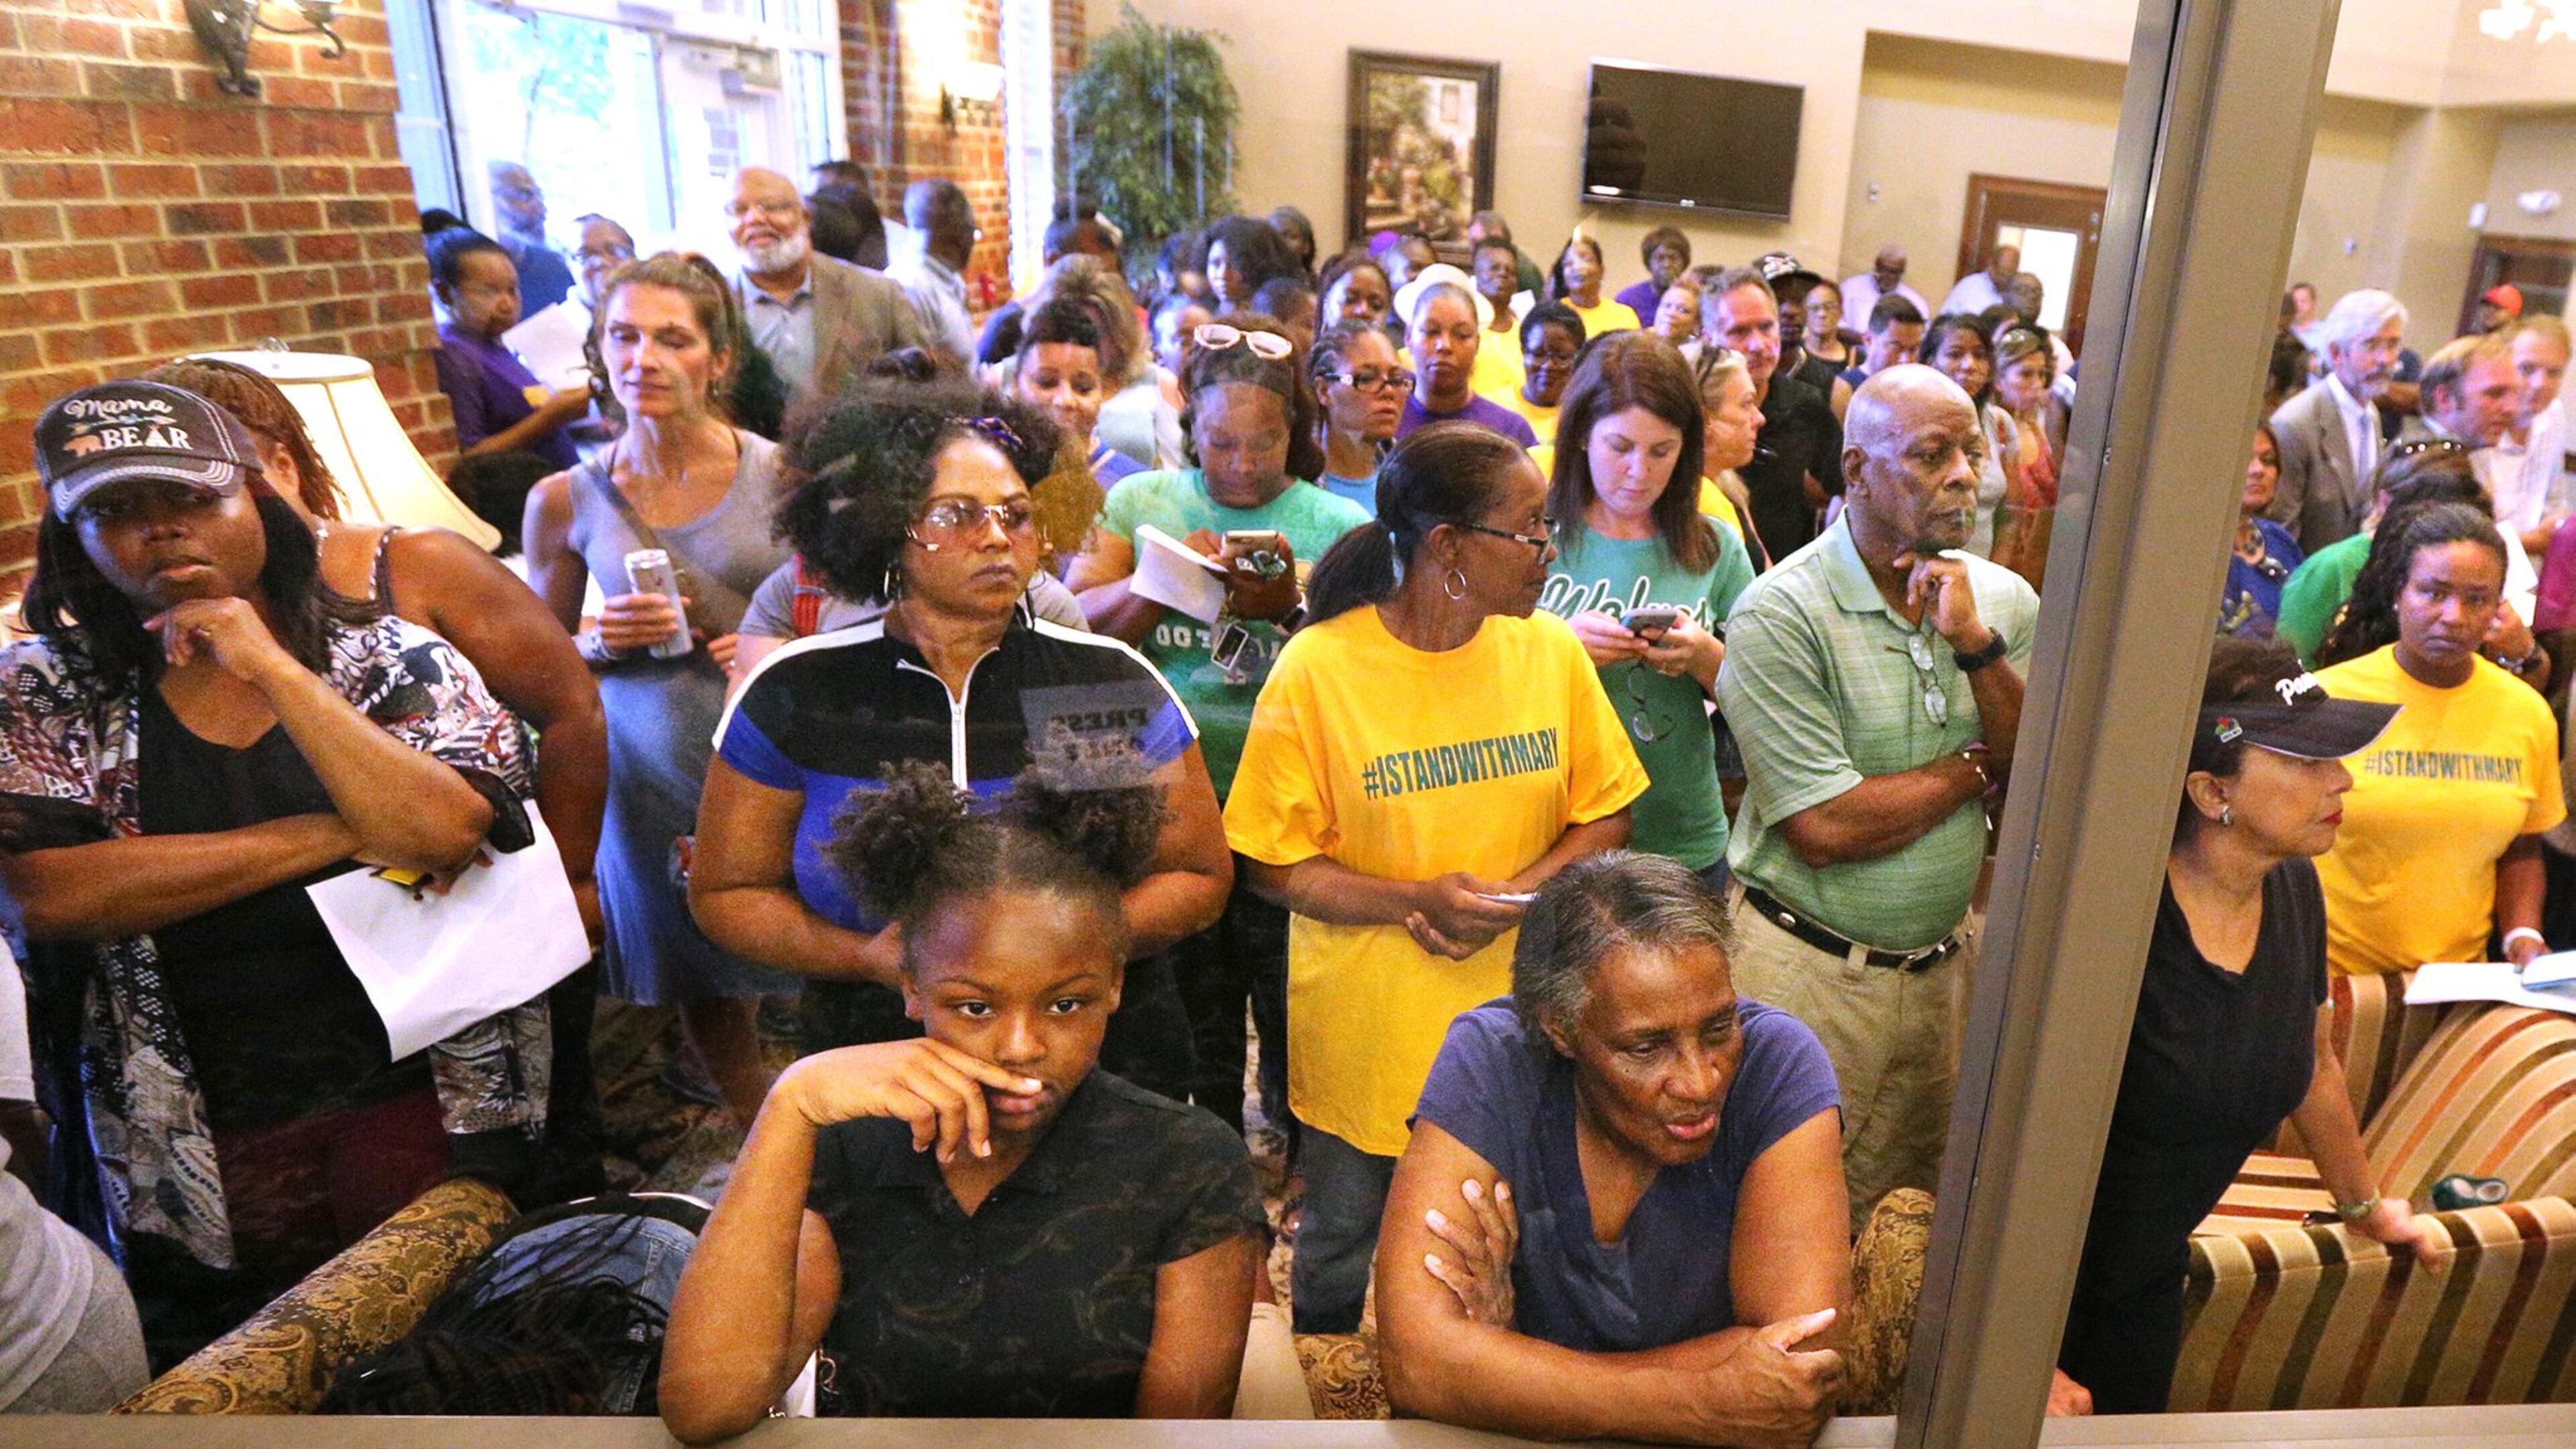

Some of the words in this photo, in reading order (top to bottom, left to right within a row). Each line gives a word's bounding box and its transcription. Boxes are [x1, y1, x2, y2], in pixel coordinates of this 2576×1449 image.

[101, 425, 194, 450] BEAR
[1362, 727, 1559, 800] #ISTANDWITHMARY
[2365, 750, 2523, 785] #ISTANDWITHMARY
